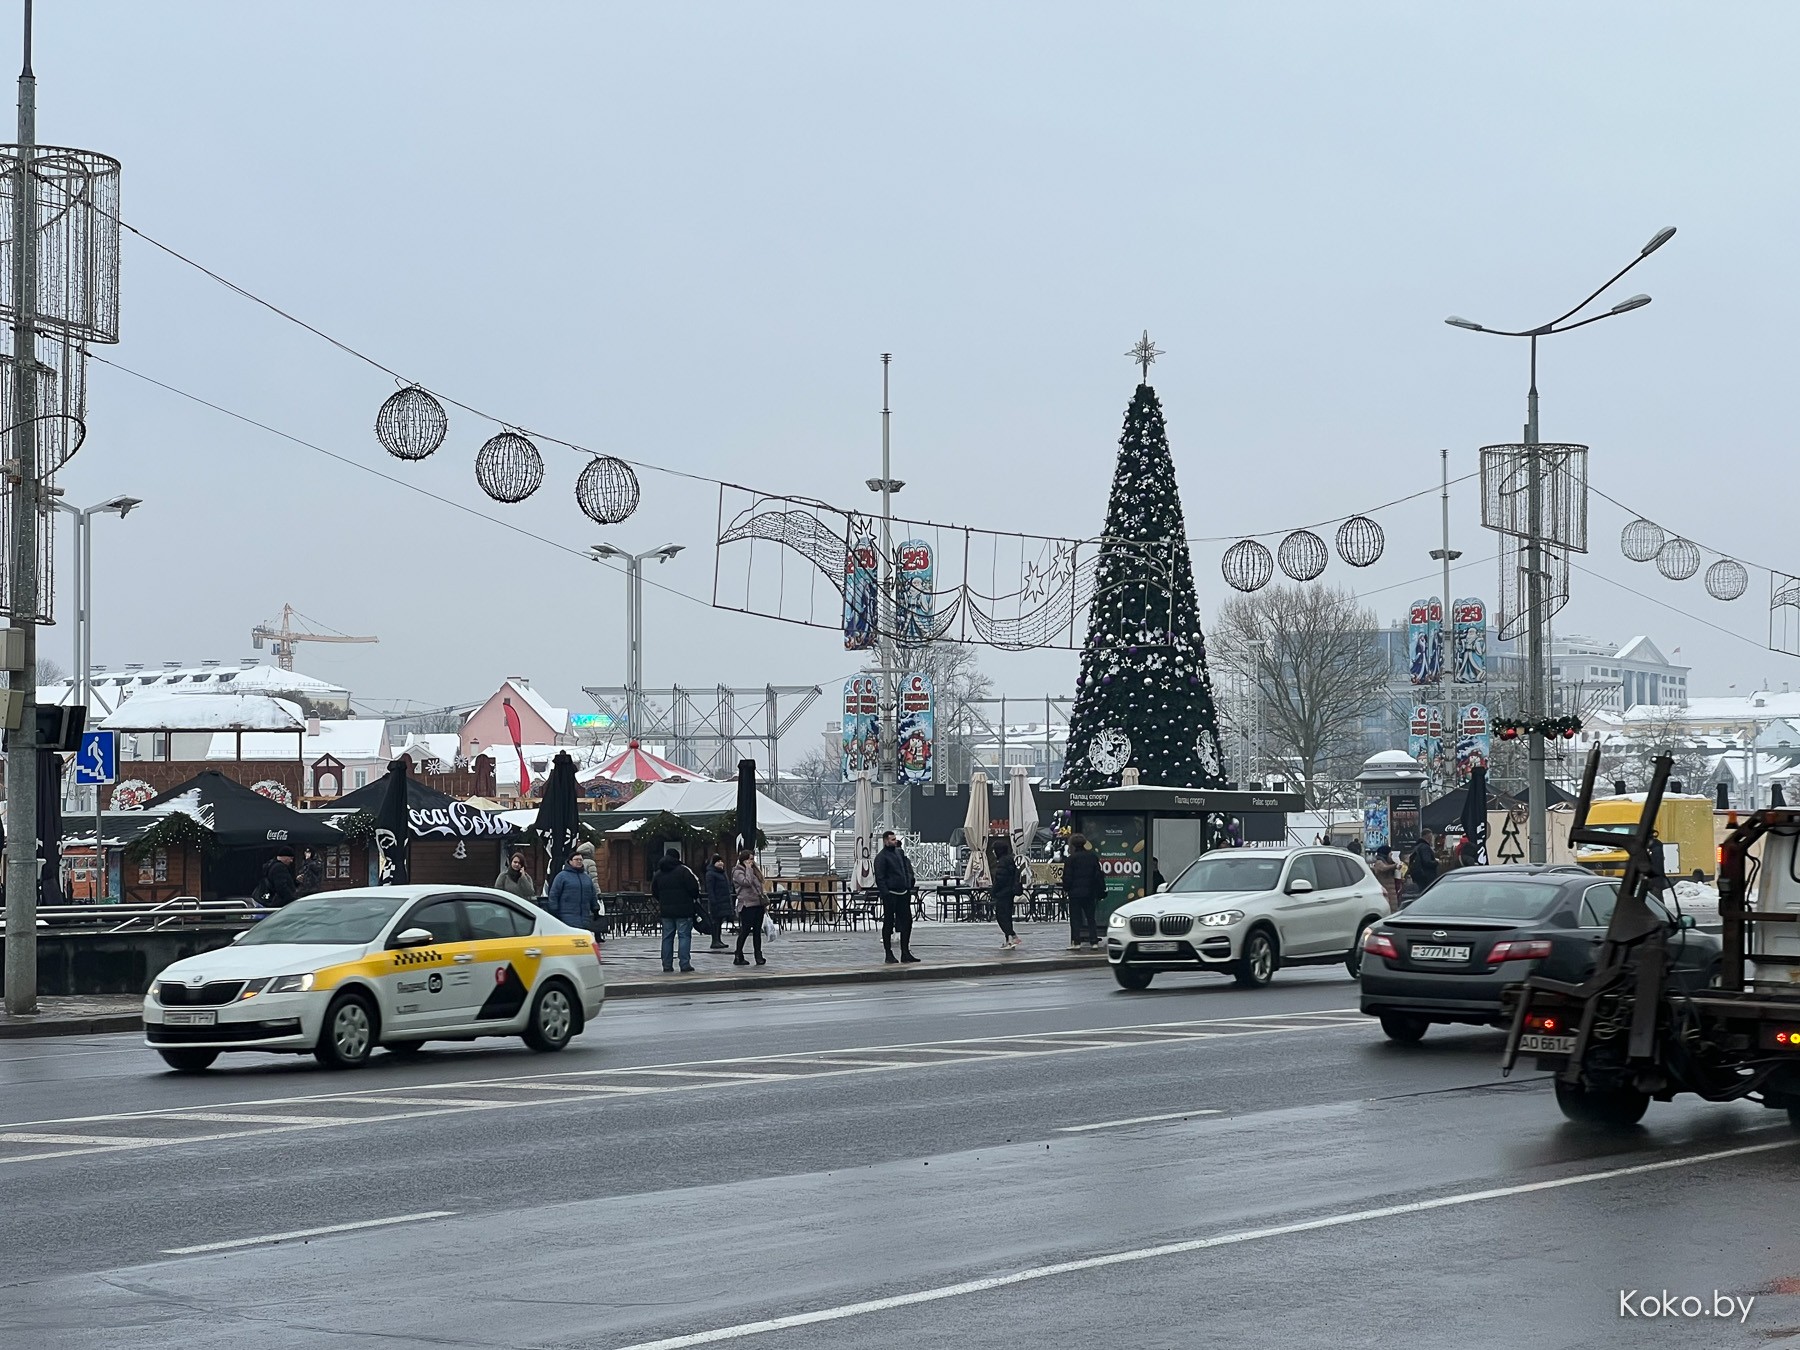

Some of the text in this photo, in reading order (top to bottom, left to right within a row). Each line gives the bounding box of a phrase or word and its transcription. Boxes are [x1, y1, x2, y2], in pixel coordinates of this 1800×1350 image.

[902, 546, 930, 570] 23
[1461, 605, 1483, 622] 23
[1089, 793, 1109, 801] спорту
[407, 801, 512, 836] oca-Cola
[1114, 861, 1142, 874] 000
